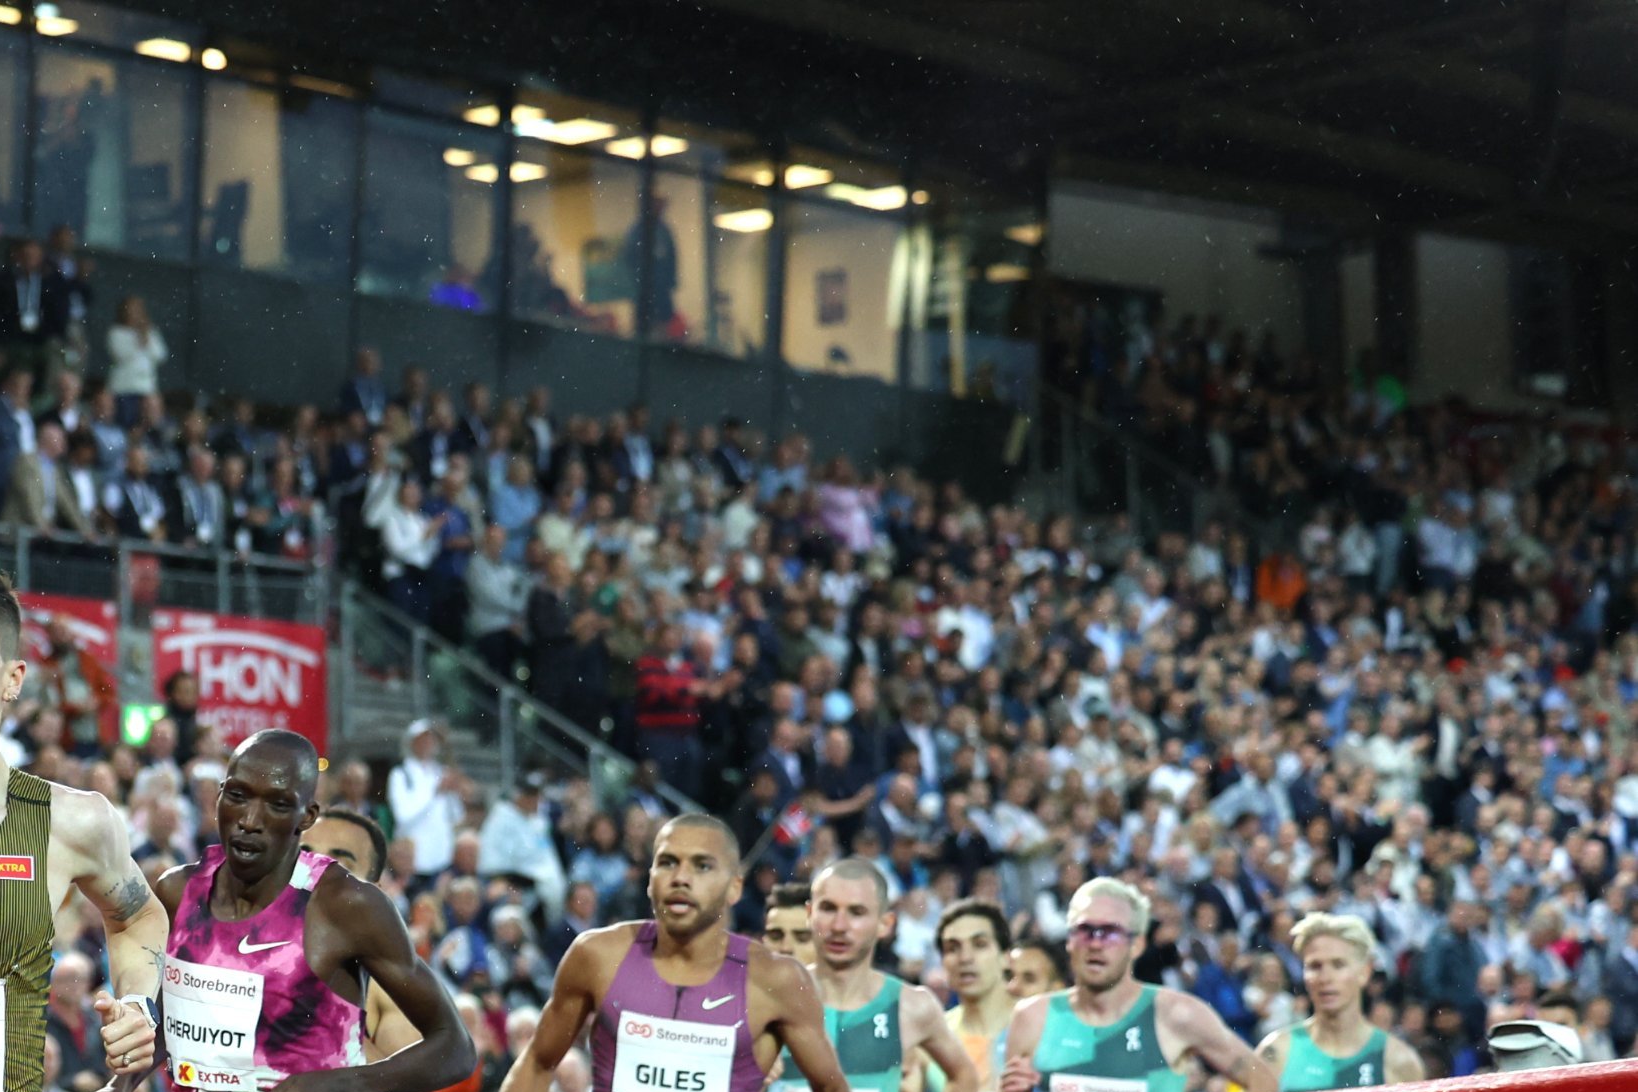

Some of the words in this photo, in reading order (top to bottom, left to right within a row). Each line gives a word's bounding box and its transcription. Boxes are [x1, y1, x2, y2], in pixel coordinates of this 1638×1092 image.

[161, 631, 319, 707] THON
[182, 972, 256, 998] Storebrand
[166, 1015, 246, 1049] CHERUIYOT
[656, 1028, 728, 1047] Storebrand
[198, 1071, 241, 1085] EXTRA
[636, 1064, 707, 1092] GILES
